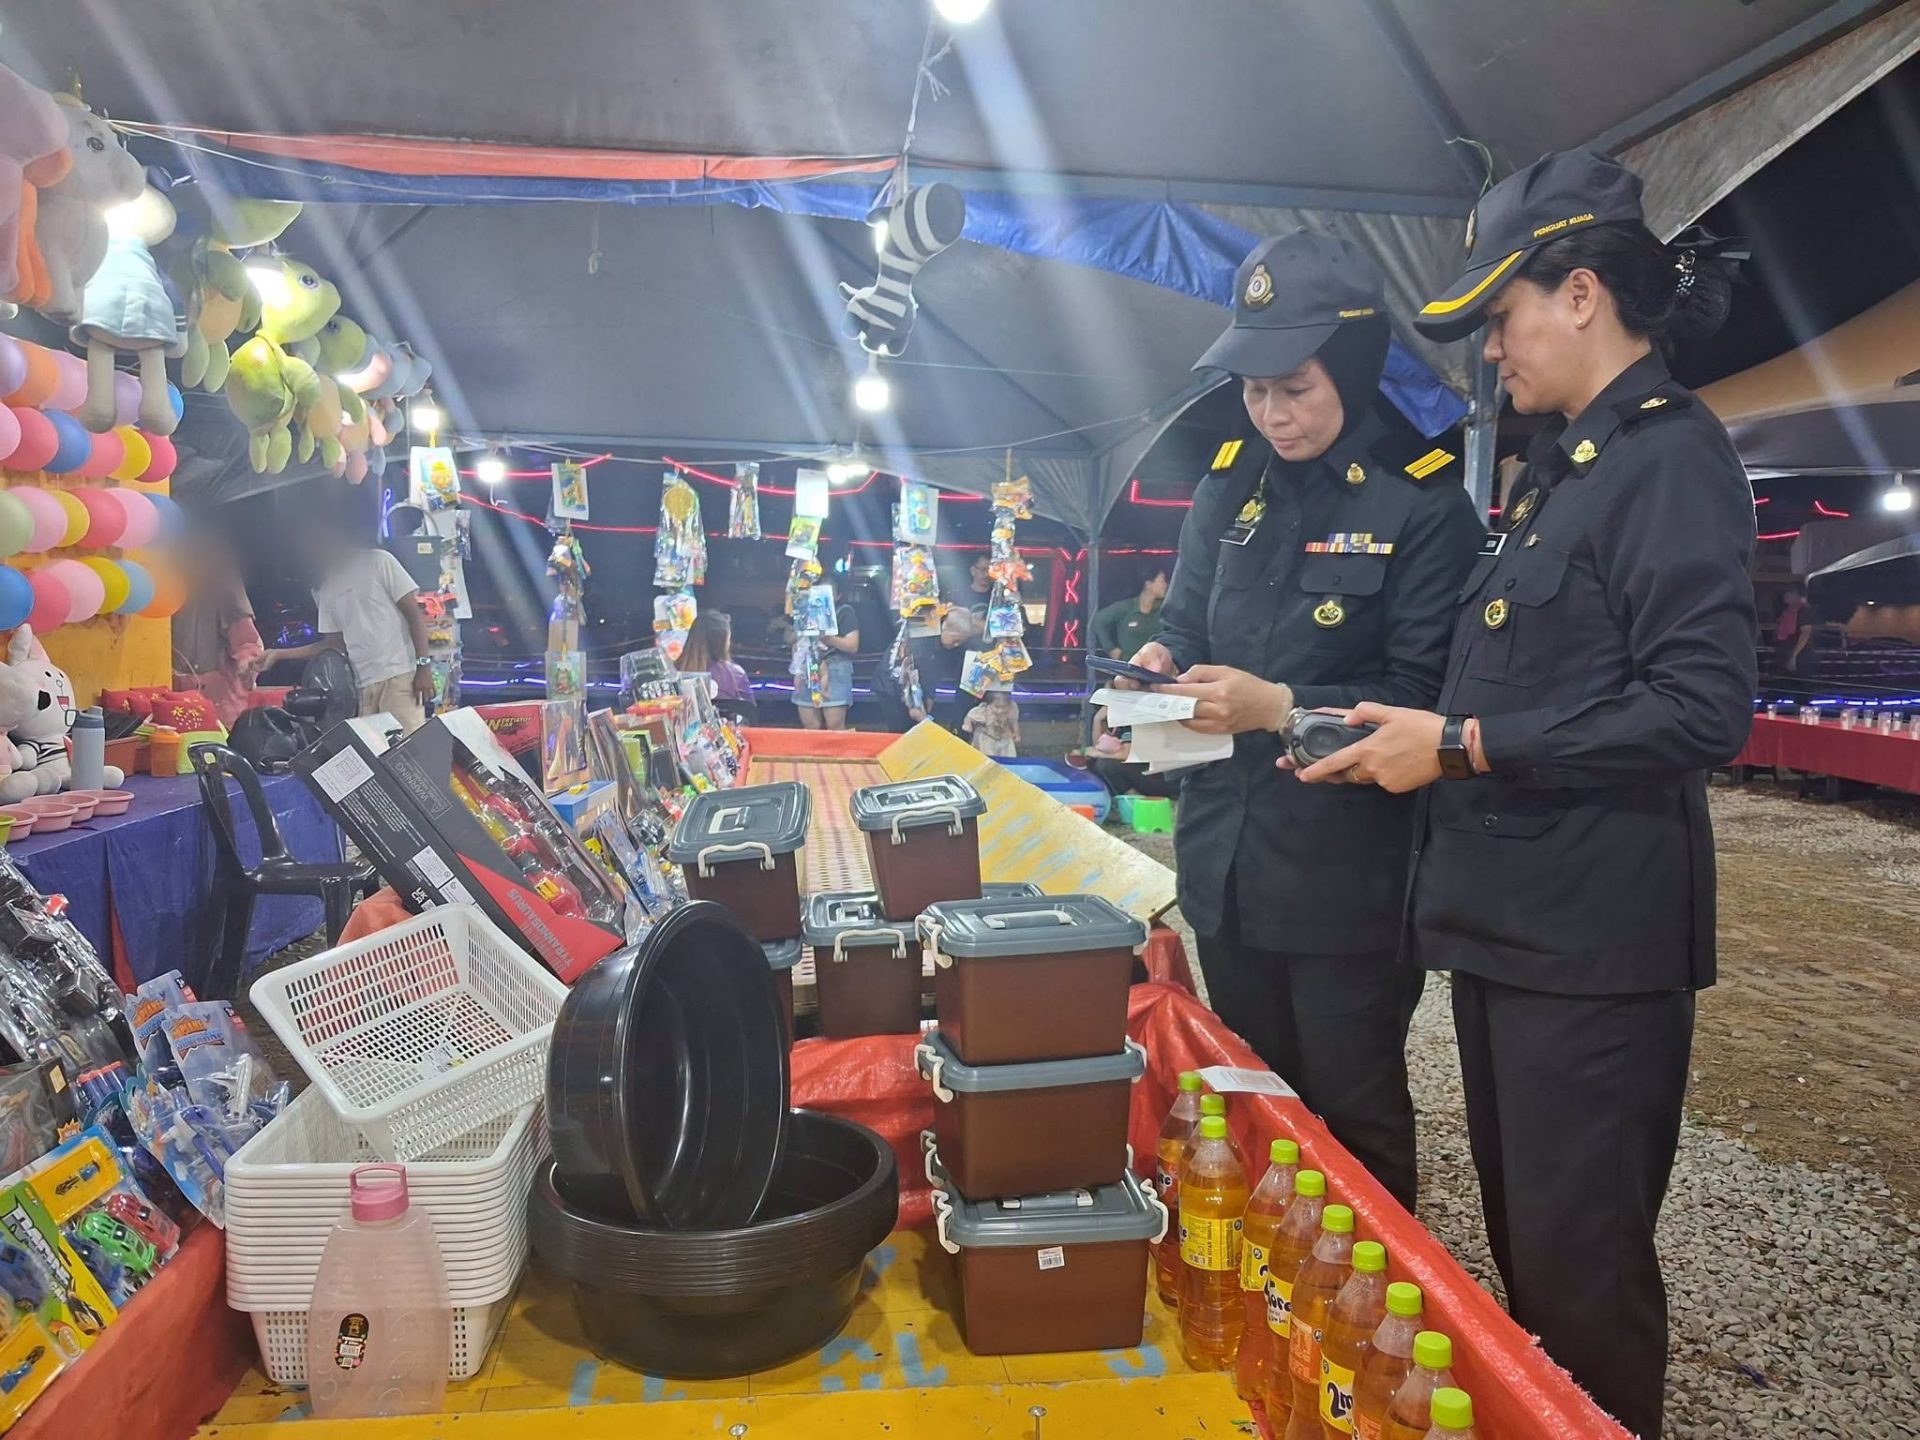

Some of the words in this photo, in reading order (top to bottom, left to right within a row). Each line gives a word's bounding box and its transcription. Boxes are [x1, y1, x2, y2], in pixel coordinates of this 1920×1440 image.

[1533, 219, 1567, 237] PENGUAT
[1569, 213, 1594, 224] KUASA
[395, 762, 429, 801] WARNING
[506, 888, 574, 967] TYRANNOSAURUS
